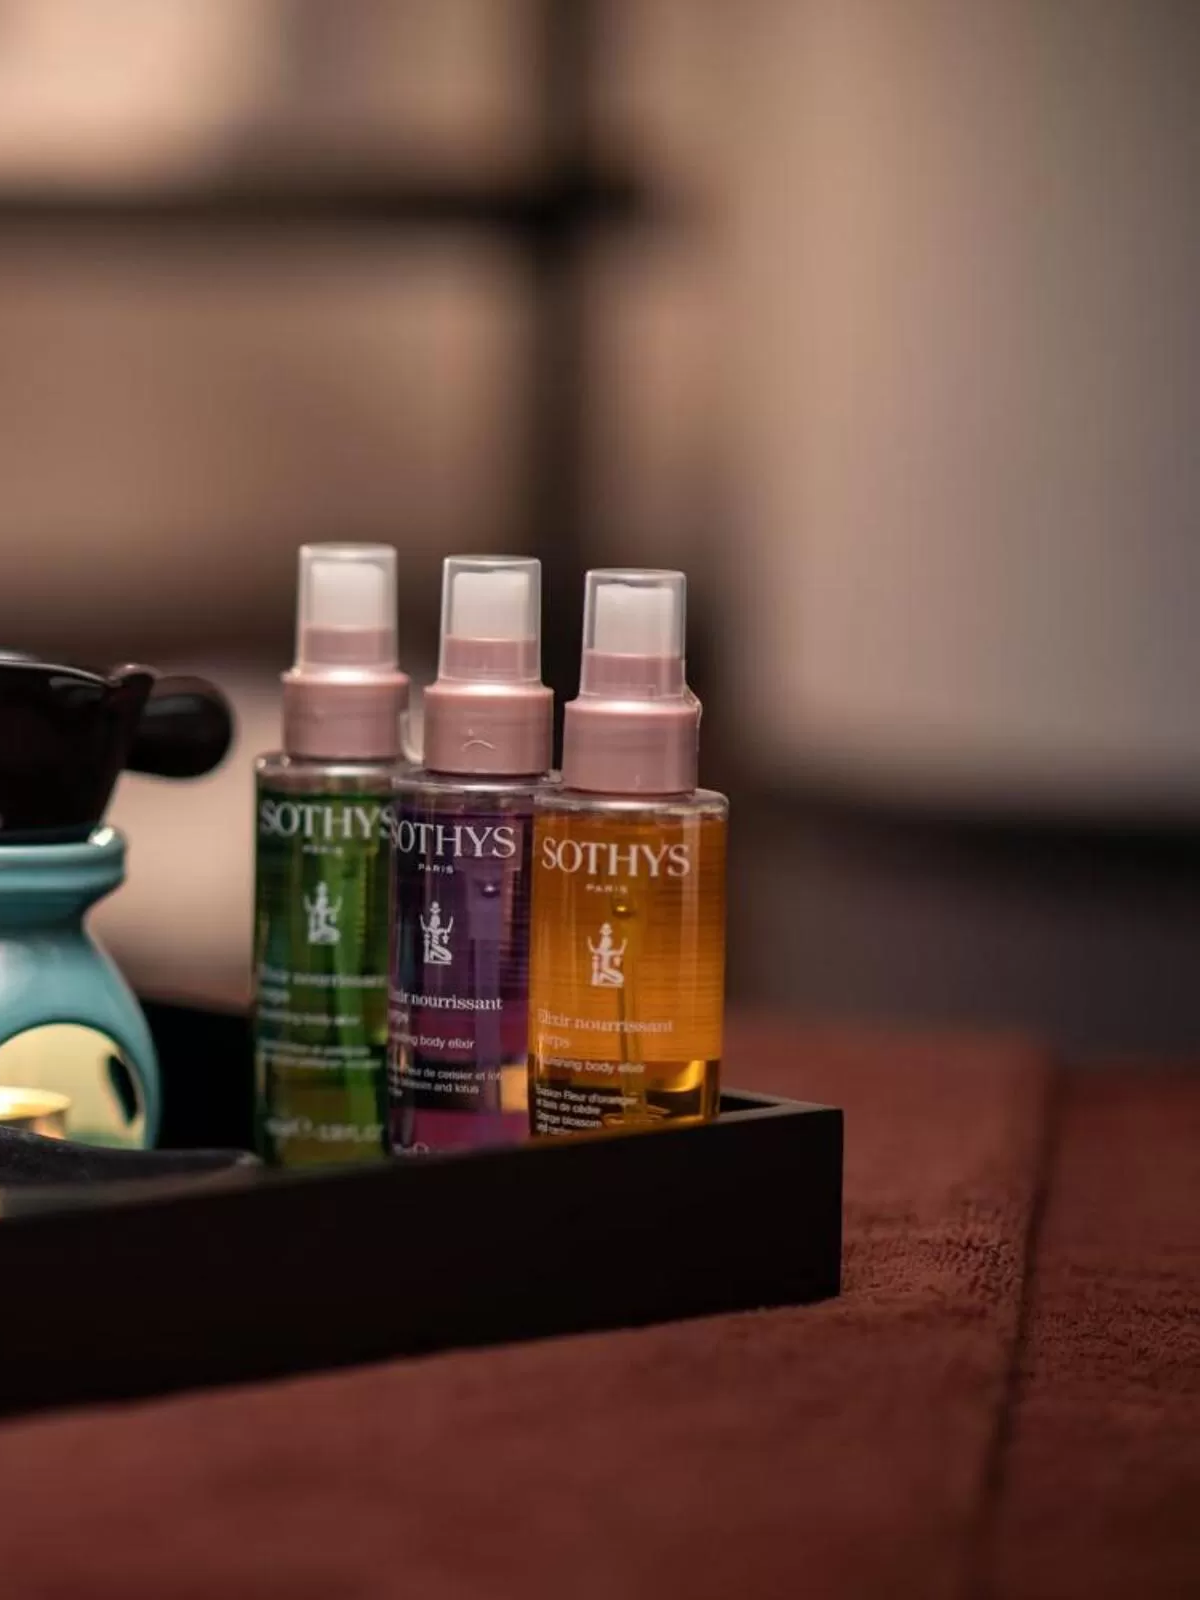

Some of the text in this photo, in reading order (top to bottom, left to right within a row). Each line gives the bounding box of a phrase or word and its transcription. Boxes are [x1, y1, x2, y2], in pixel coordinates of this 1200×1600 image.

[260, 801, 397, 841] SOTHYS
[542, 837, 690, 877] SOTHYS
[418, 863, 454, 874] PARIS
[586, 884, 628, 894] PARIS
[411, 994, 503, 1010] nourrissant
[420, 1035, 444, 1049] body
[448, 1038, 475, 1049] elixir
[585, 1061, 614, 1074] body
